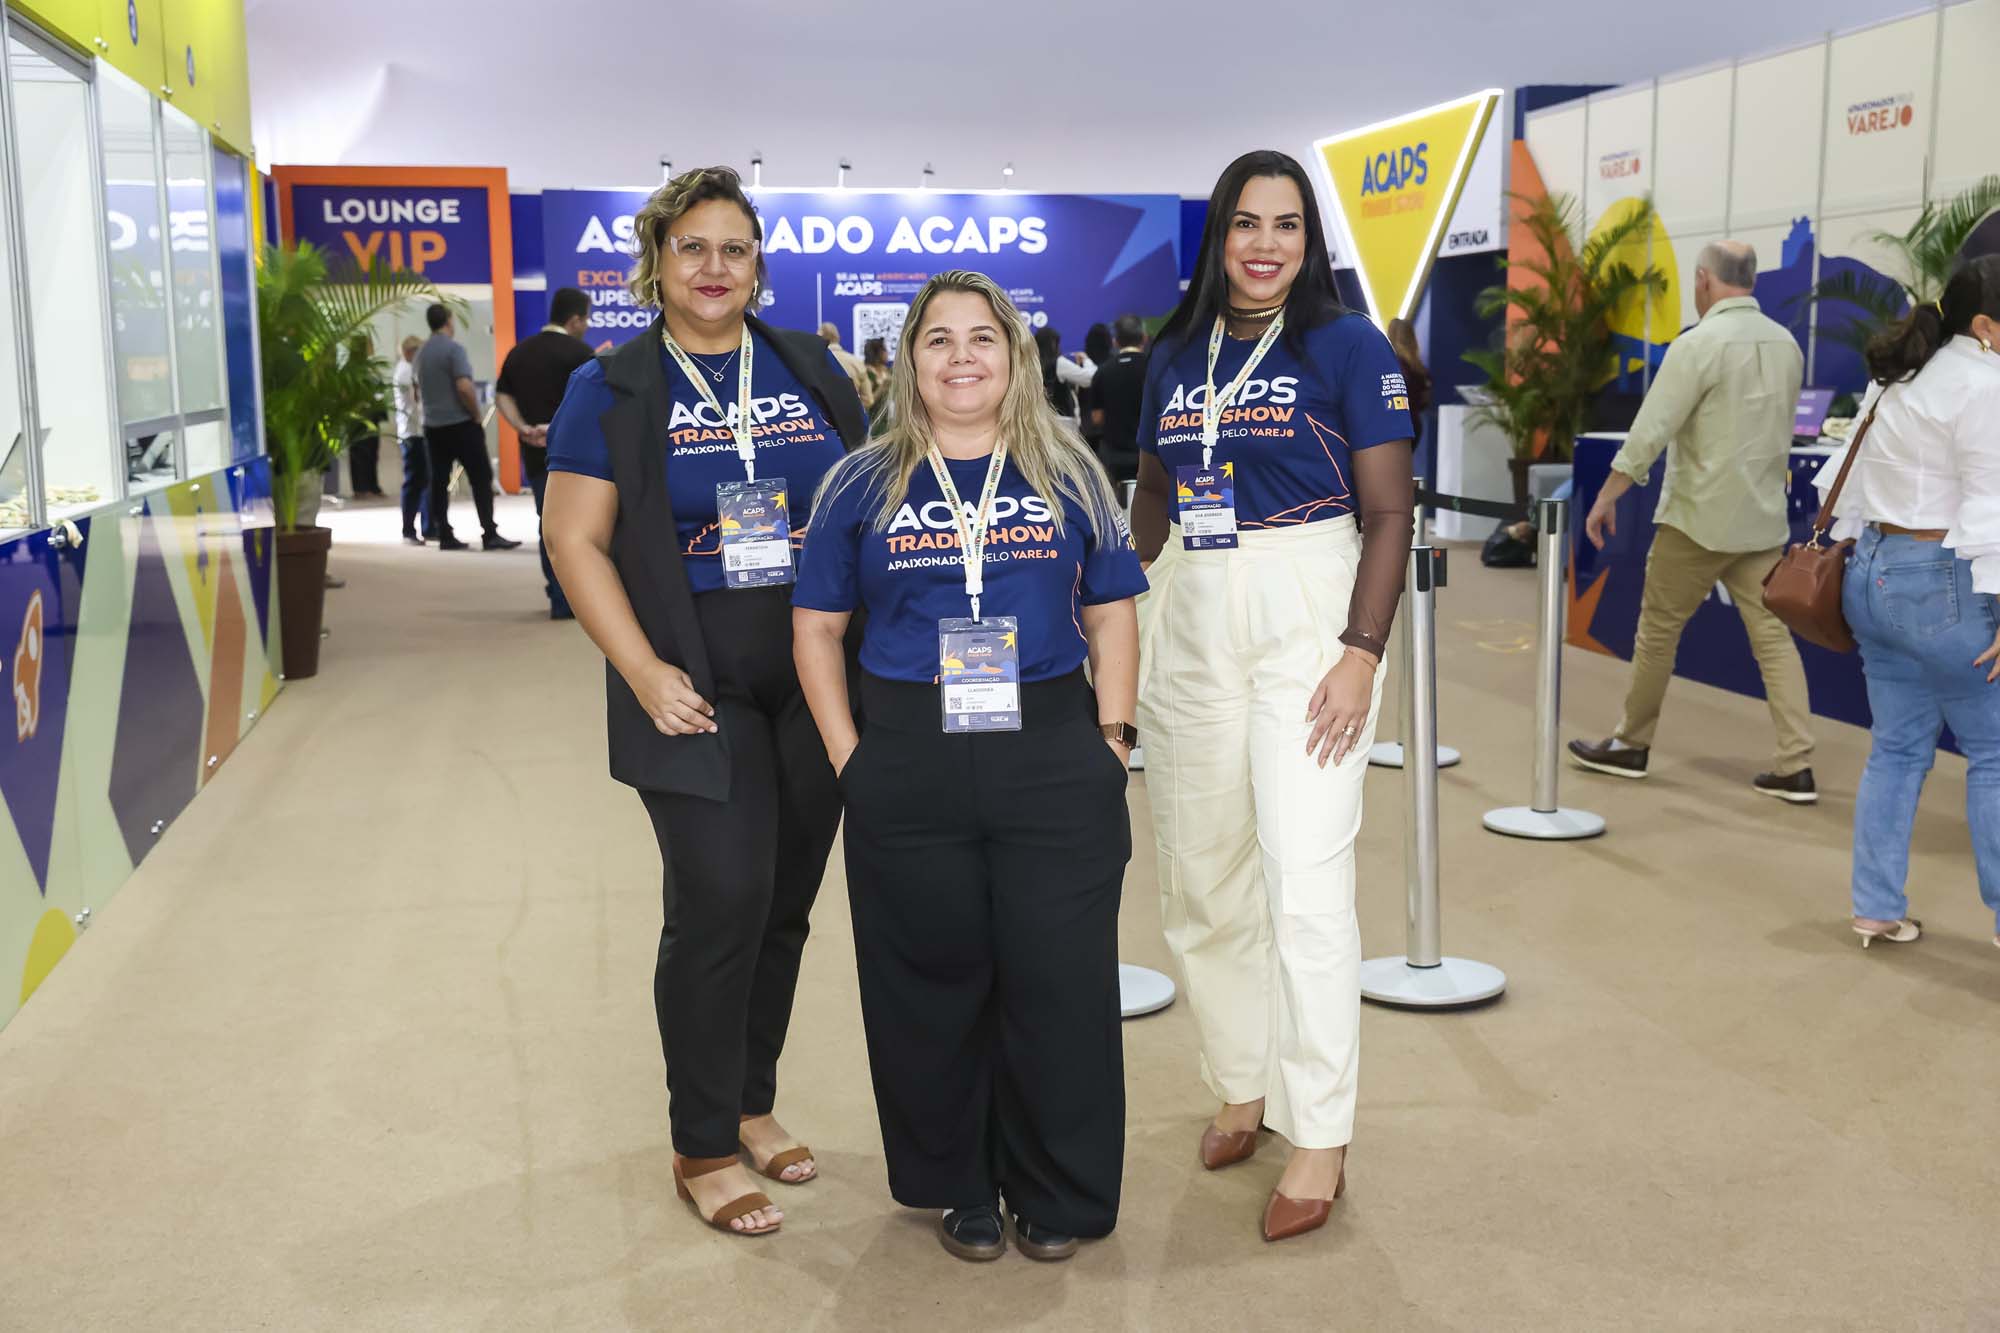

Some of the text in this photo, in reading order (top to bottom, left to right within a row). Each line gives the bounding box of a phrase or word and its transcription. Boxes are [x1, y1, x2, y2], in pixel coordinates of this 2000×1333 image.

[1847, 105, 1912, 136] VAREJO
[1361, 142, 1428, 197] ACAPS
[323, 199, 461, 224] LOUNGE
[886, 215, 1048, 254] ACAPS
[1449, 230, 1489, 249] ENTRADA
[342, 230, 447, 273] VIP
[834, 281, 882, 296] ACAPS
[1162, 376, 1299, 416] ACAPS
[669, 428, 734, 445] TRAD
[752, 417, 815, 437] SHOW
[1160, 406, 1295, 431] TRAD SHOW
[757, 438, 786, 449] PELO
[786, 433, 825, 443] VAREJO
[1158, 428, 1294, 446] APAIXONADS PELO VAREJO
[888, 496, 1053, 534] ACAPS
[887, 555, 966, 571] APAIXONADO
[1011, 549, 1058, 560] VAREJO
[967, 646, 992, 654] ACAPS
